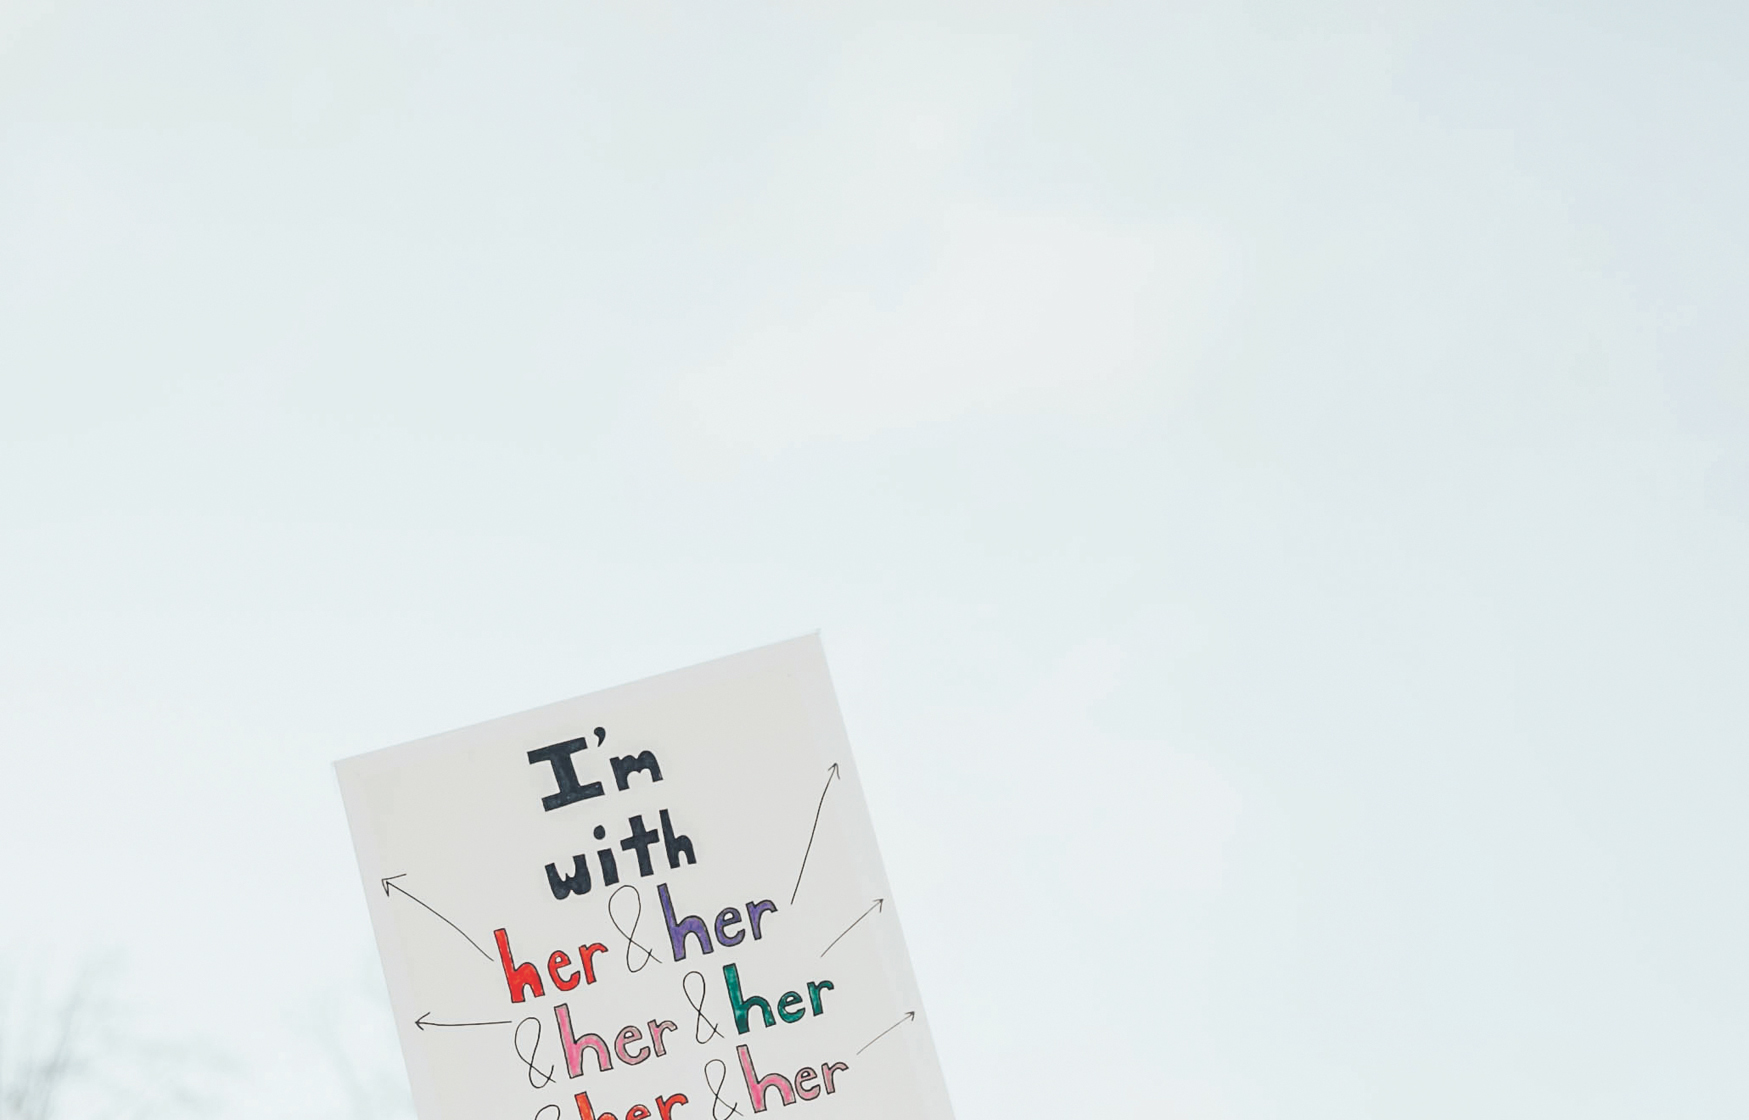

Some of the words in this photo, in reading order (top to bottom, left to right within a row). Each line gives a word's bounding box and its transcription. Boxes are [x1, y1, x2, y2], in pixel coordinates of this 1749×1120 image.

[527, 727, 663, 812] I'm
[544, 808, 698, 901] with
[493, 928, 609, 1004] her
[656, 883, 778, 962] her
[553, 1003, 679, 1079] her
[722, 963, 834, 1035] her
[736, 1044, 849, 1114] her
